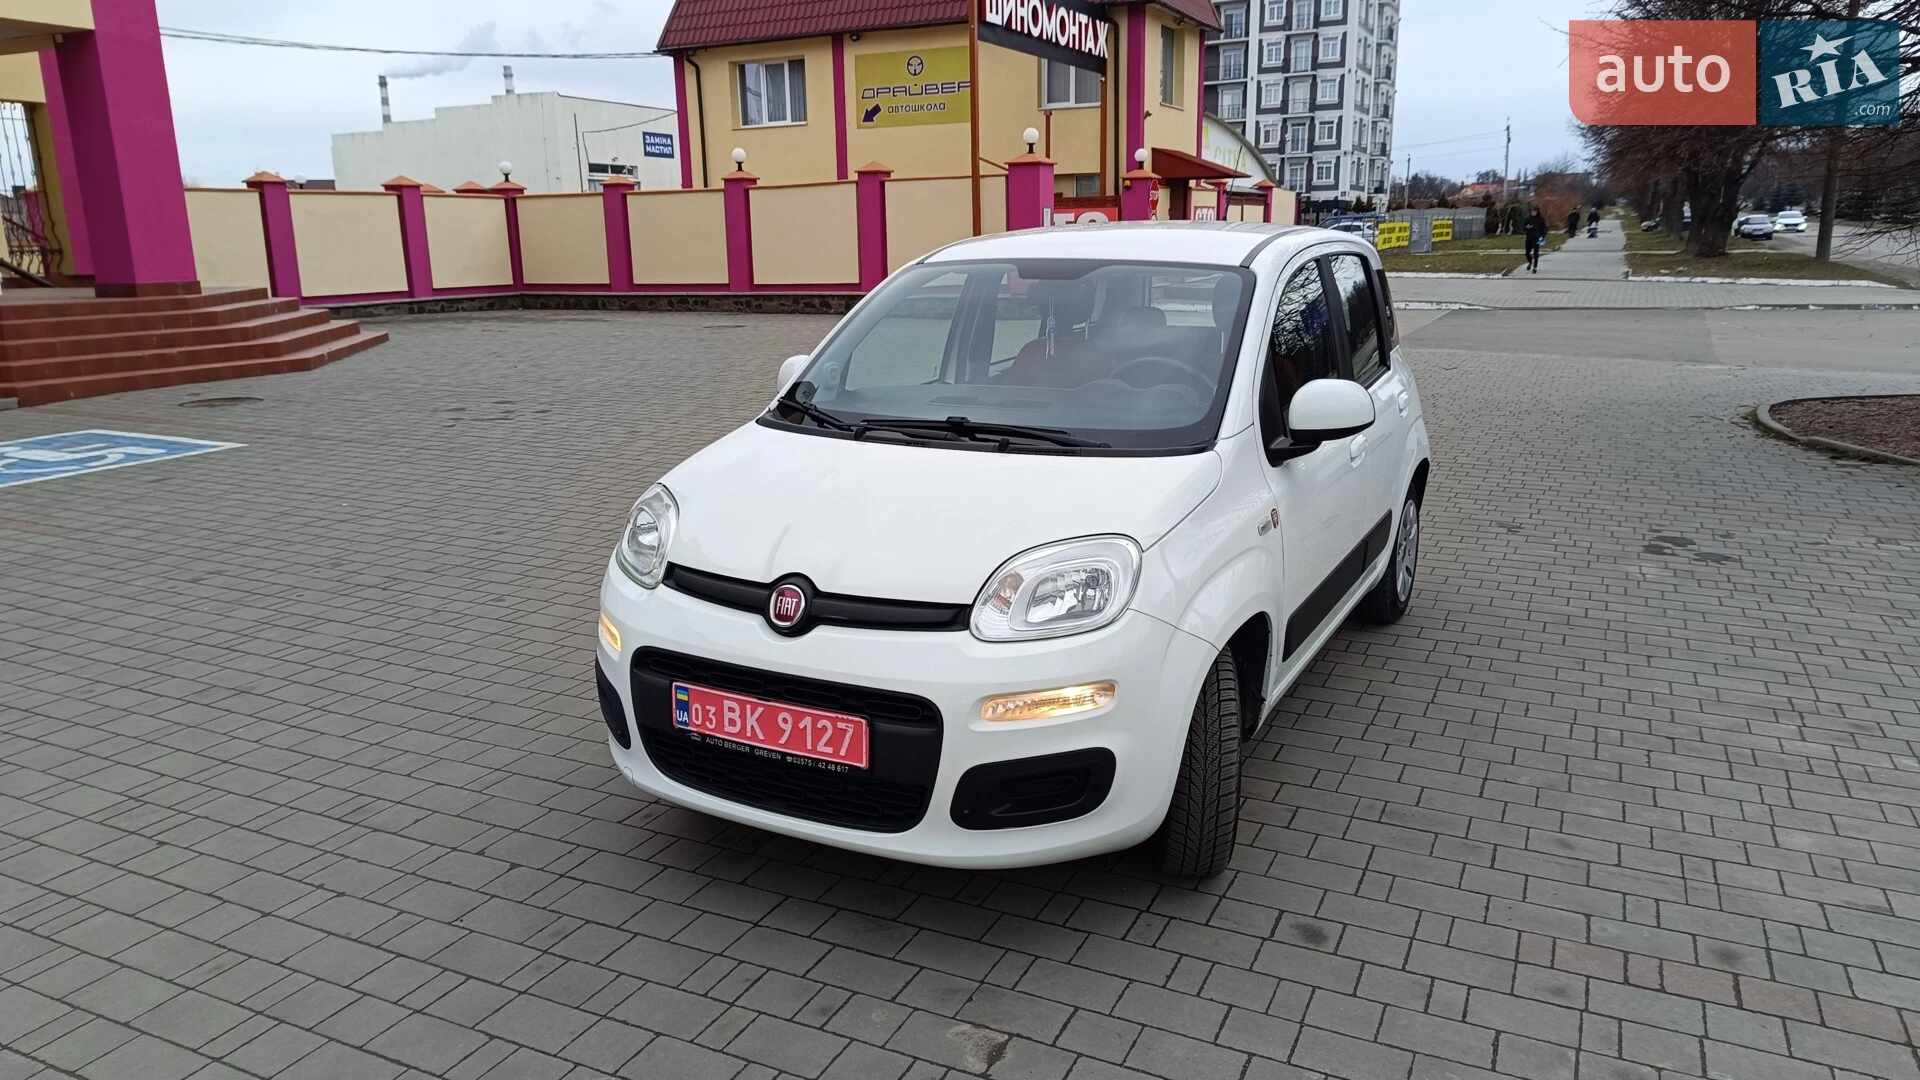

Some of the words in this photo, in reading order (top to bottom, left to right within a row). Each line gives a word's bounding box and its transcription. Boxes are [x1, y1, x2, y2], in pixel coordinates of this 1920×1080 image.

[985, 0, 1109, 59] ШИНОМОНТАЖ
[887, 102, 946, 114] автошкола
[776, 596, 798, 616] FIAT
[676, 710, 689, 723] UA
[692, 703, 716, 729] 03
[723, 700, 765, 740] BK
[777, 712, 854, 756] 9127
[706, 737, 723, 746] AUTO
[724, 741, 750, 752] BERGER
[754, 749, 781, 759] GREVEN
